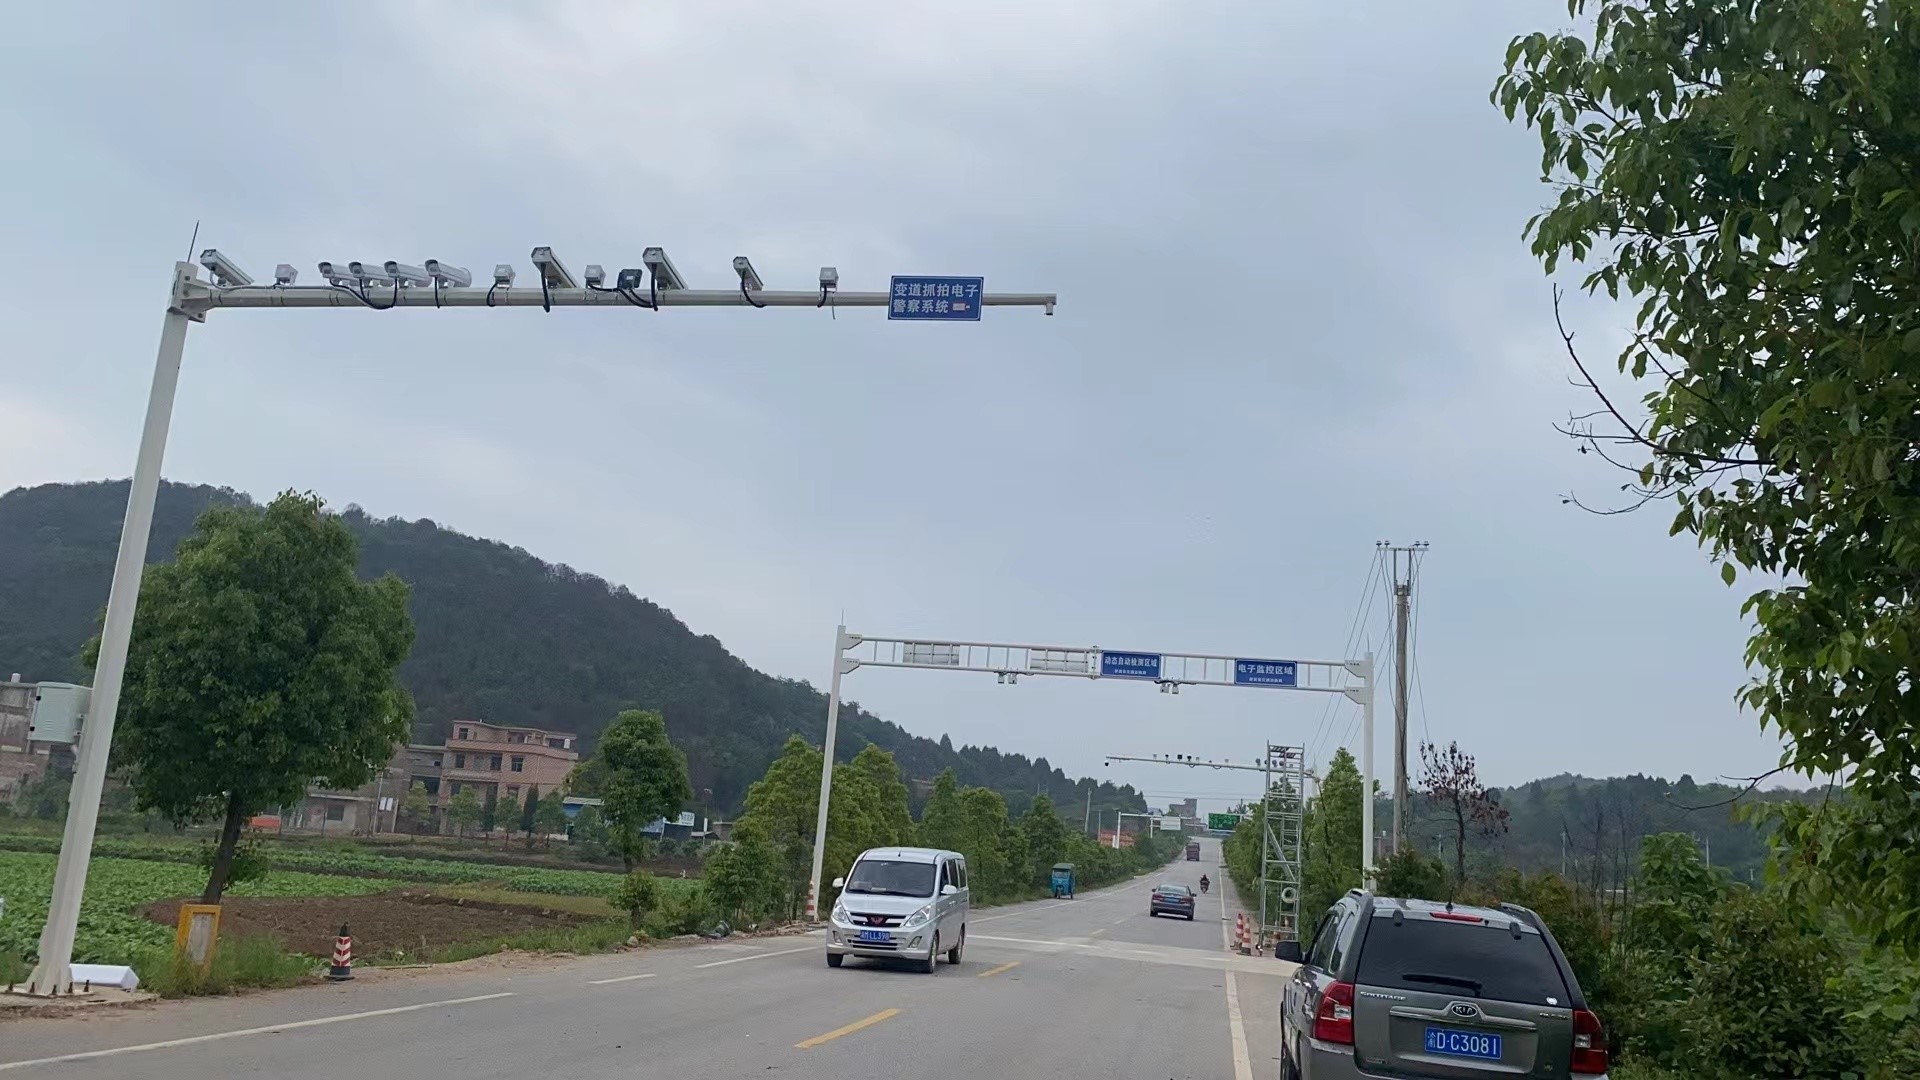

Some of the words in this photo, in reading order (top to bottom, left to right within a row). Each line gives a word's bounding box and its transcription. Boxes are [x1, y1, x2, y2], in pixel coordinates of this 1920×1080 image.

[894, 283, 979, 298] 变道抓拍电子
[893, 299, 949, 314] 警察系统
[1104, 656, 1158, 667] 动态自动检测区域
[1238, 664, 1293, 675] 电子监控区域
[1455, 1006, 1474, 1015] KIA
